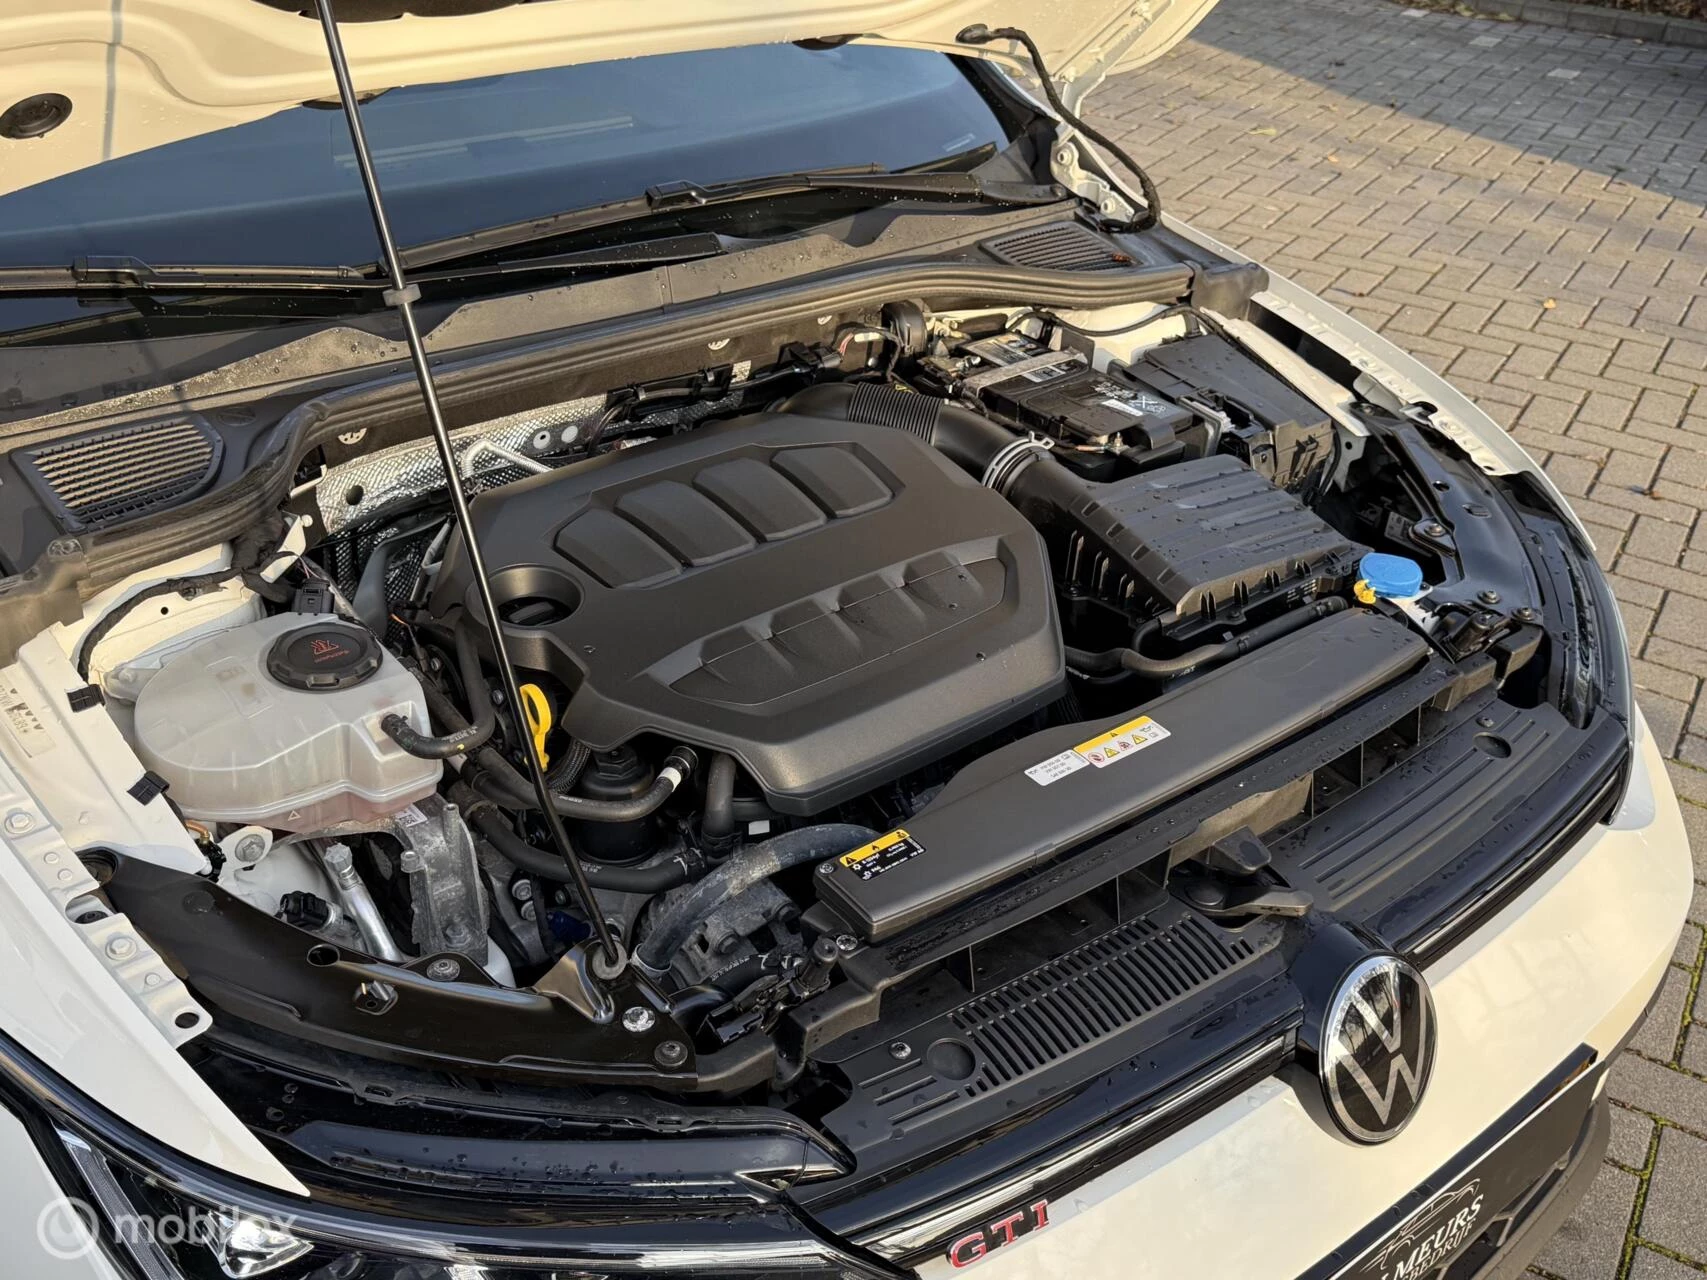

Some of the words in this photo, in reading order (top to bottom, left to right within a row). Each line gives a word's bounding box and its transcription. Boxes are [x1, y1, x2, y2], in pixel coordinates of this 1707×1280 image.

[948, 1199, 1050, 1269] GTI
[1393, 1194, 1484, 1280] MEURS
[1402, 1217, 1476, 1280] BEDRIJF
